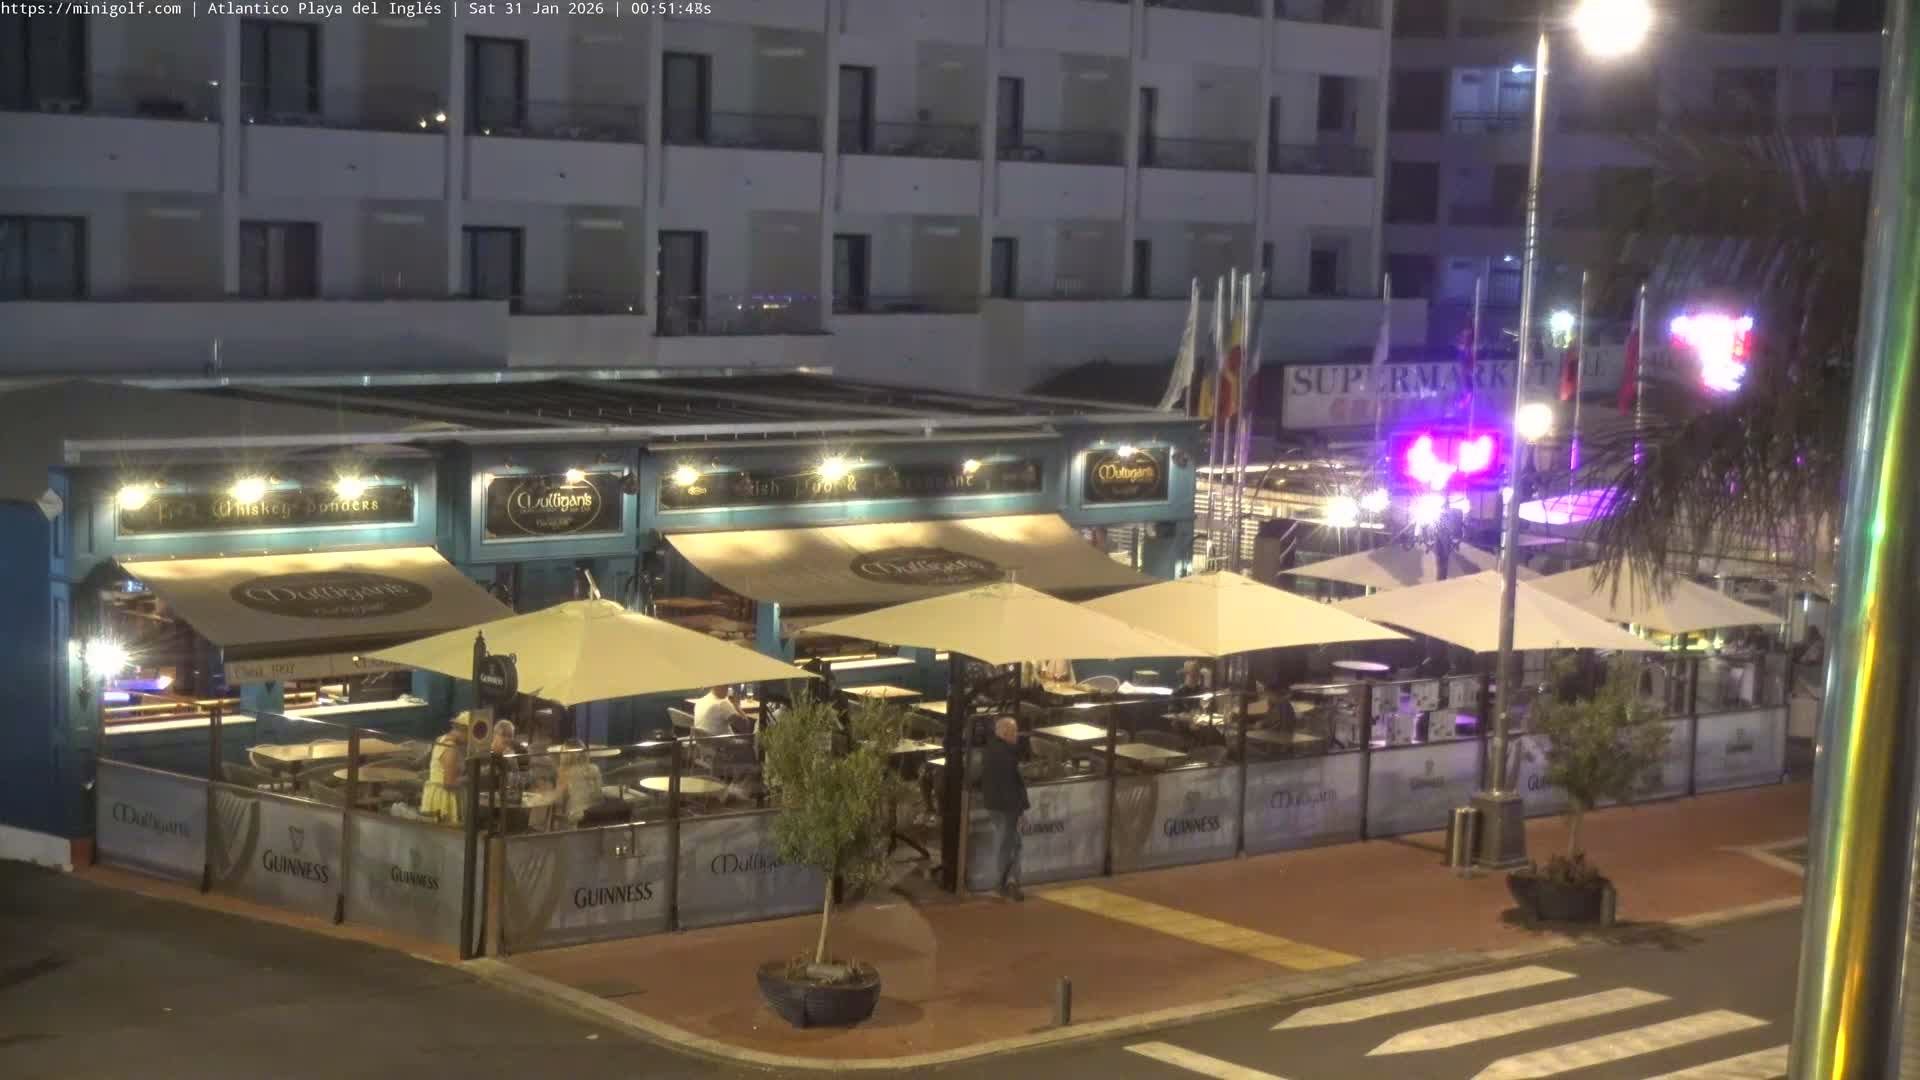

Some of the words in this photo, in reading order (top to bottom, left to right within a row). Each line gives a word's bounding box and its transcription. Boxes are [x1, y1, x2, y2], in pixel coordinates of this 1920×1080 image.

[1290, 360, 1554, 396] SUPRMARKT
[1163, 815, 1221, 837] GUINNESS
[262, 849, 329, 883] GUINNESS
[391, 865, 439, 890] GUINNESS
[574, 882, 653, 909] GUINNESS
